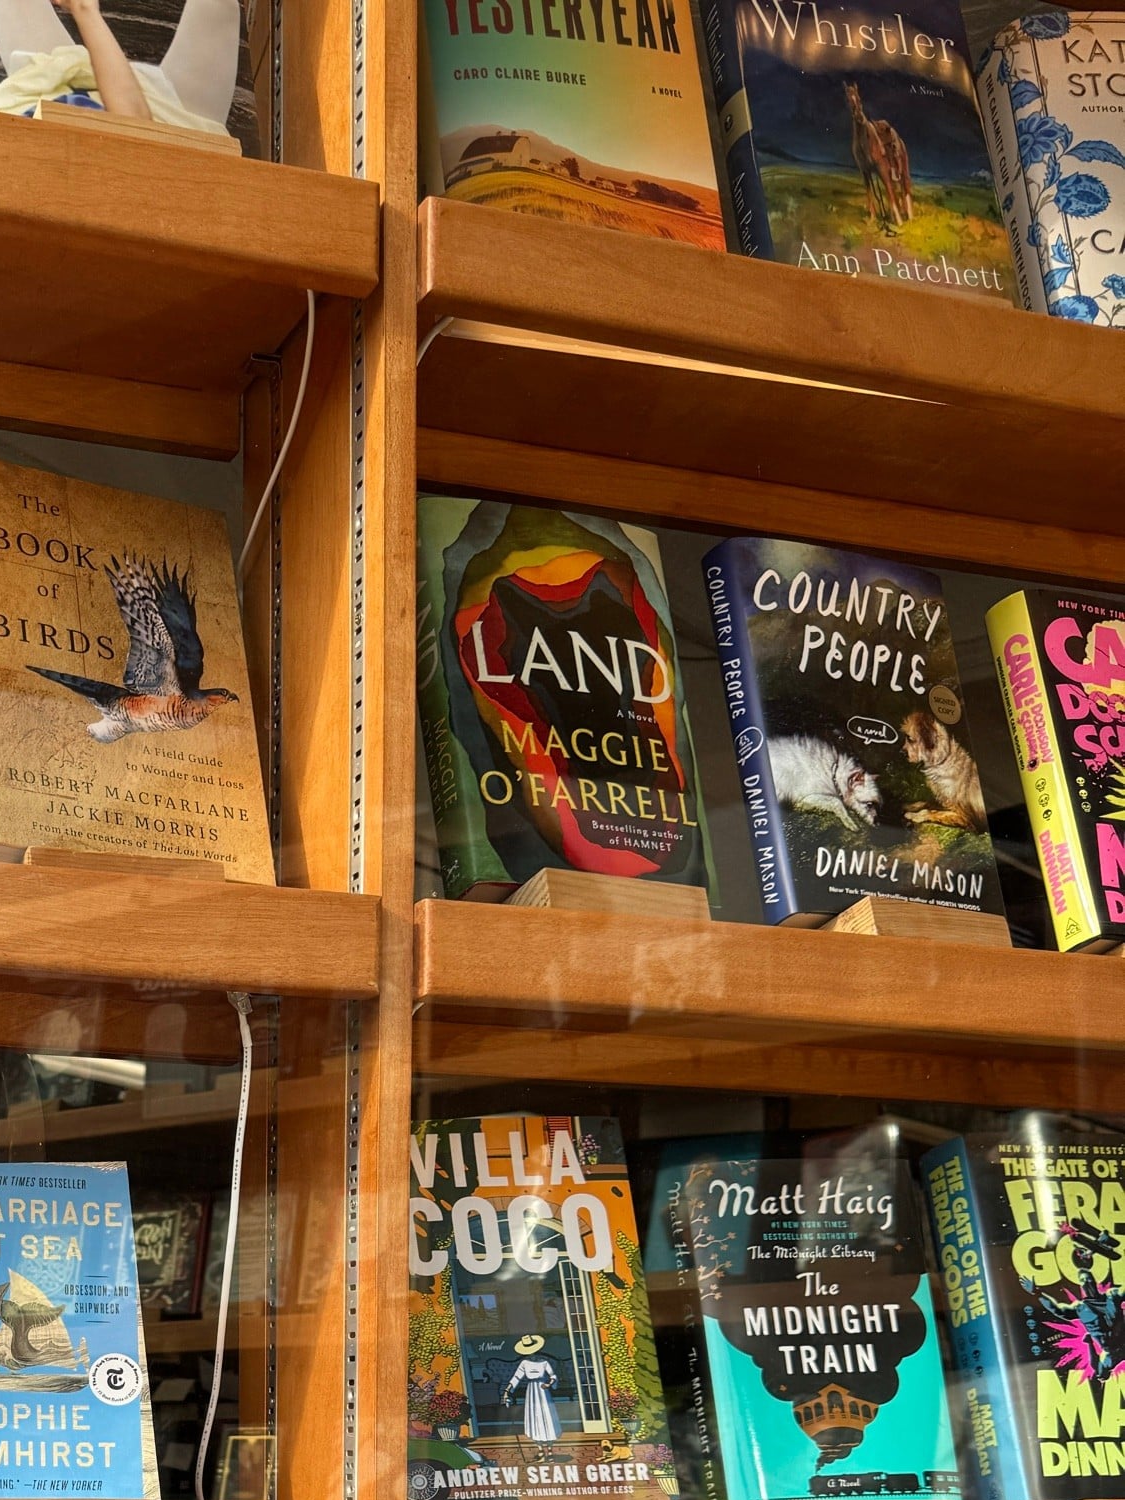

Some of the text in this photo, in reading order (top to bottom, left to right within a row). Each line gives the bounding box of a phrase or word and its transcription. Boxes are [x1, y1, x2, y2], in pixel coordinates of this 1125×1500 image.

[749, 0, 955, 63] Whistler
[454, 69, 587, 86] CARO CLAIRE BURKE
[798, 241, 1004, 292] Ann Patchett
[17, 493, 61, 517] The
[36, 582, 61, 600] of
[753, 569, 943, 643] COUNTRY
[472, 621, 673, 704] LAND
[799, 624, 927, 695] PEOPLE
[501, 720, 670, 773] MAGGIE
[8, 767, 250, 823] ROBERT MACFARLANE
[45, 800, 220, 842] JACKIE MORRIS
[480, 769, 698, 827] O'FARRELL
[815, 846, 983, 900] DANIEL MASON
[409, 1130, 586, 1188] VILLA
[708, 1176, 893, 1230] Matt Haig
[21, 1236, 83, 1261] SEA
[408, 1193, 613, 1276] COCO
[796, 1272, 840, 1296] The
[743, 1304, 900, 1336] MIDNIGHT
[778, 1344, 877, 1374] TRAIN
[434, 1462, 649, 1489] ANDREW SEAN GREER
